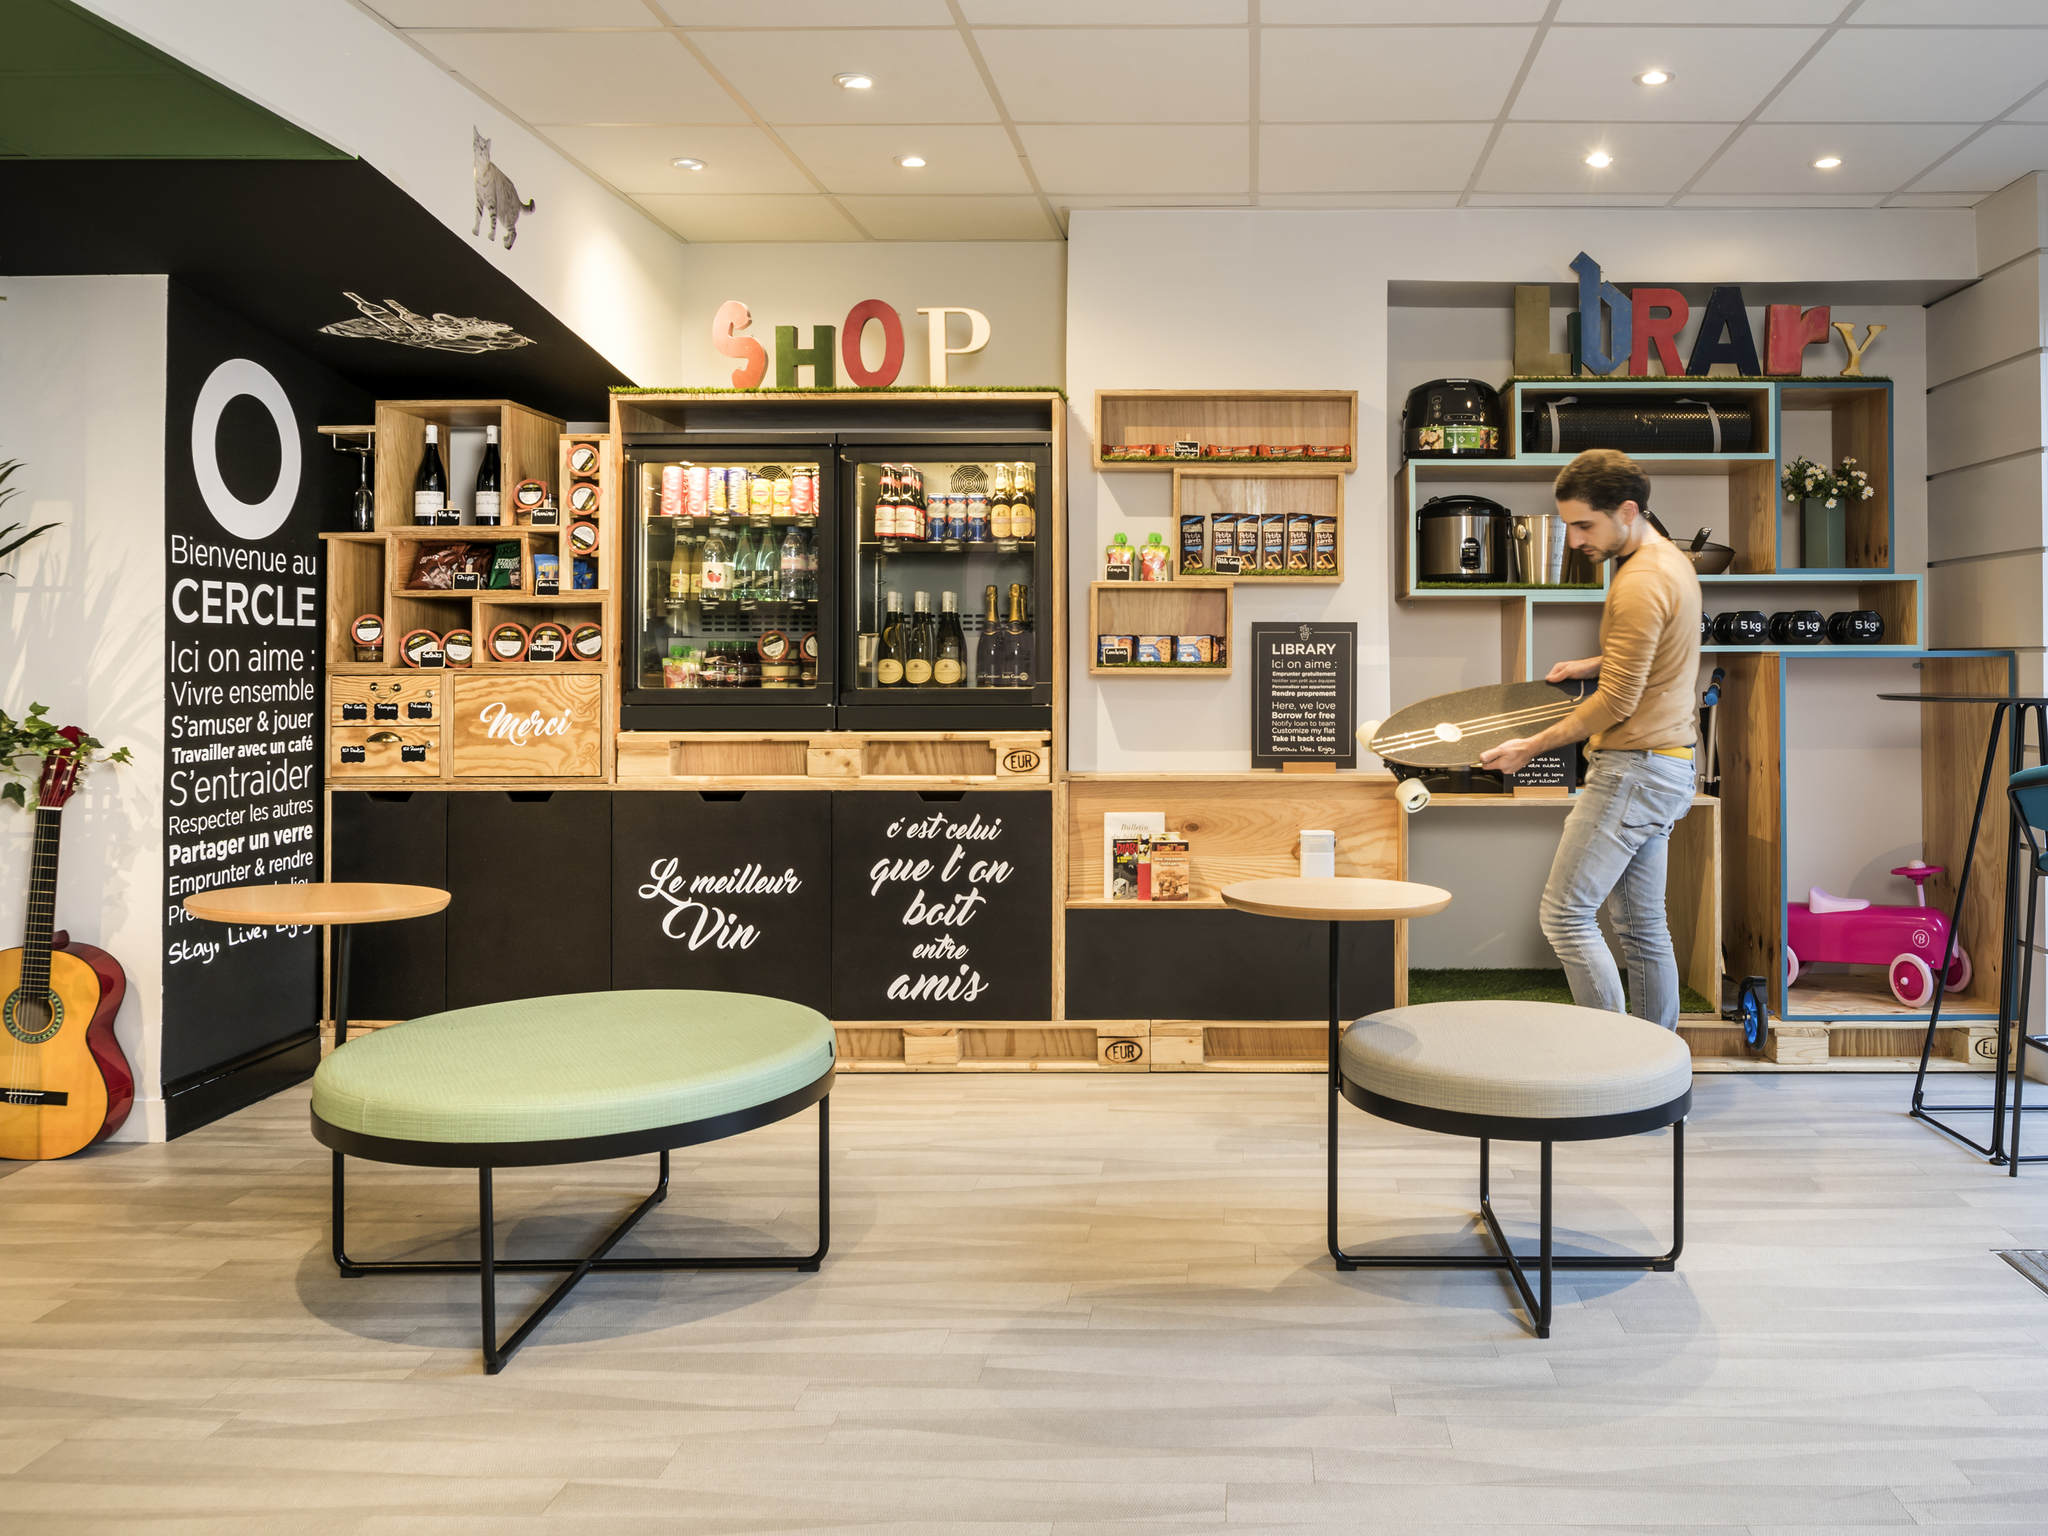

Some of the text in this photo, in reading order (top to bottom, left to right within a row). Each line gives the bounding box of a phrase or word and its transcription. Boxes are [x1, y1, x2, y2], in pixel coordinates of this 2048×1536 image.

[712, 299, 991, 388] SHOP
[192, 358, 302, 540] O
[171, 534, 316, 575] Bienvenue au
[172, 578, 316, 627] CERCLE
[1740, 620, 1761, 632] 5 kg
[1798, 621, 1819, 632] 5 kg
[1855, 620, 1876, 632] 5 kg
[171, 640, 199, 672] Ici
[208, 648, 239, 672] on
[248, 641, 304, 672] aime
[1272, 643, 1336, 655] LIBRARY
[1272, 659, 1284, 669] Ici
[1287, 661, 1301, 669] on
[1304, 659, 1331, 669] aime
[171, 678, 314, 706] Vivre ensemble
[1299, 702, 1314, 710] we
[1316, 701, 1336, 710] love
[257, 711, 269, 731] &
[272, 710, 314, 735] jouer
[480, 702, 573, 746] Merci
[1304, 711, 1316, 719] for
[1318, 711, 1336, 719] free
[172, 735, 313, 764] Travailler avec un café
[1010, 754, 1033, 770] EUR
[169, 799, 313, 836] Respecter les autres
[945, 814, 1002, 840] celui
[169, 824, 313, 866] Partager un verre
[169, 850, 313, 896] Emprunter & rendre
[638, 857, 801, 901] Le meilleur
[870, 853, 934, 896] que
[902, 887, 986, 926] boit
[662, 899, 760, 951] Vin
[168, 939, 220, 965] Stay,
[228, 926, 267, 946] Live,
[912, 934, 969, 960] entre
[887, 964, 988, 1001] amis
[1112, 1045, 1135, 1060] EUR
[1983, 1041, 1997, 1055] EU
